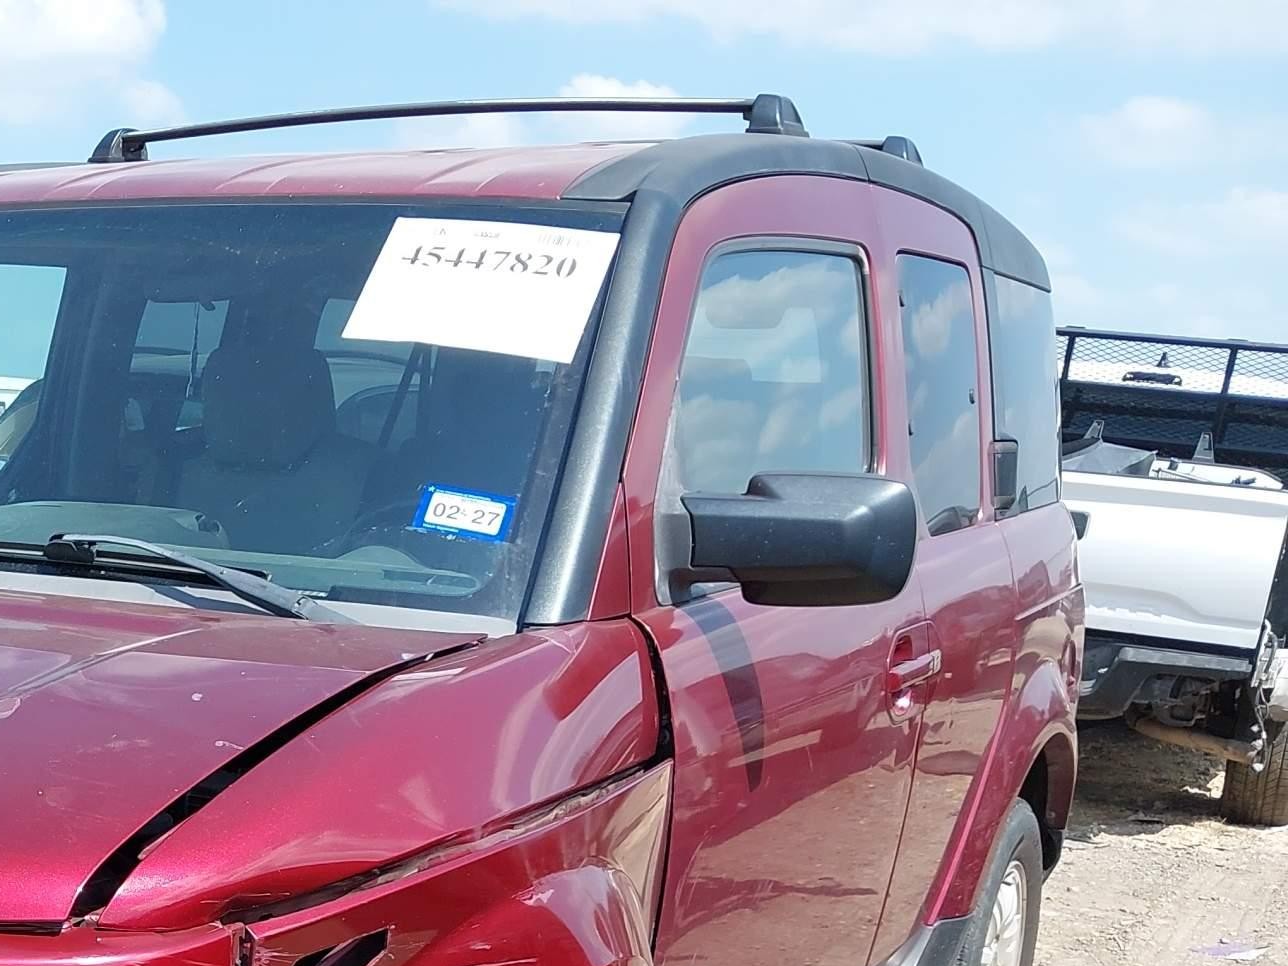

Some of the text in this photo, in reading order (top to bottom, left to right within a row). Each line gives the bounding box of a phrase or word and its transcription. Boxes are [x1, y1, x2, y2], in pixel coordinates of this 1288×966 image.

[400, 245, 578, 278] 45447820
[432, 502, 501, 526] 02 27
